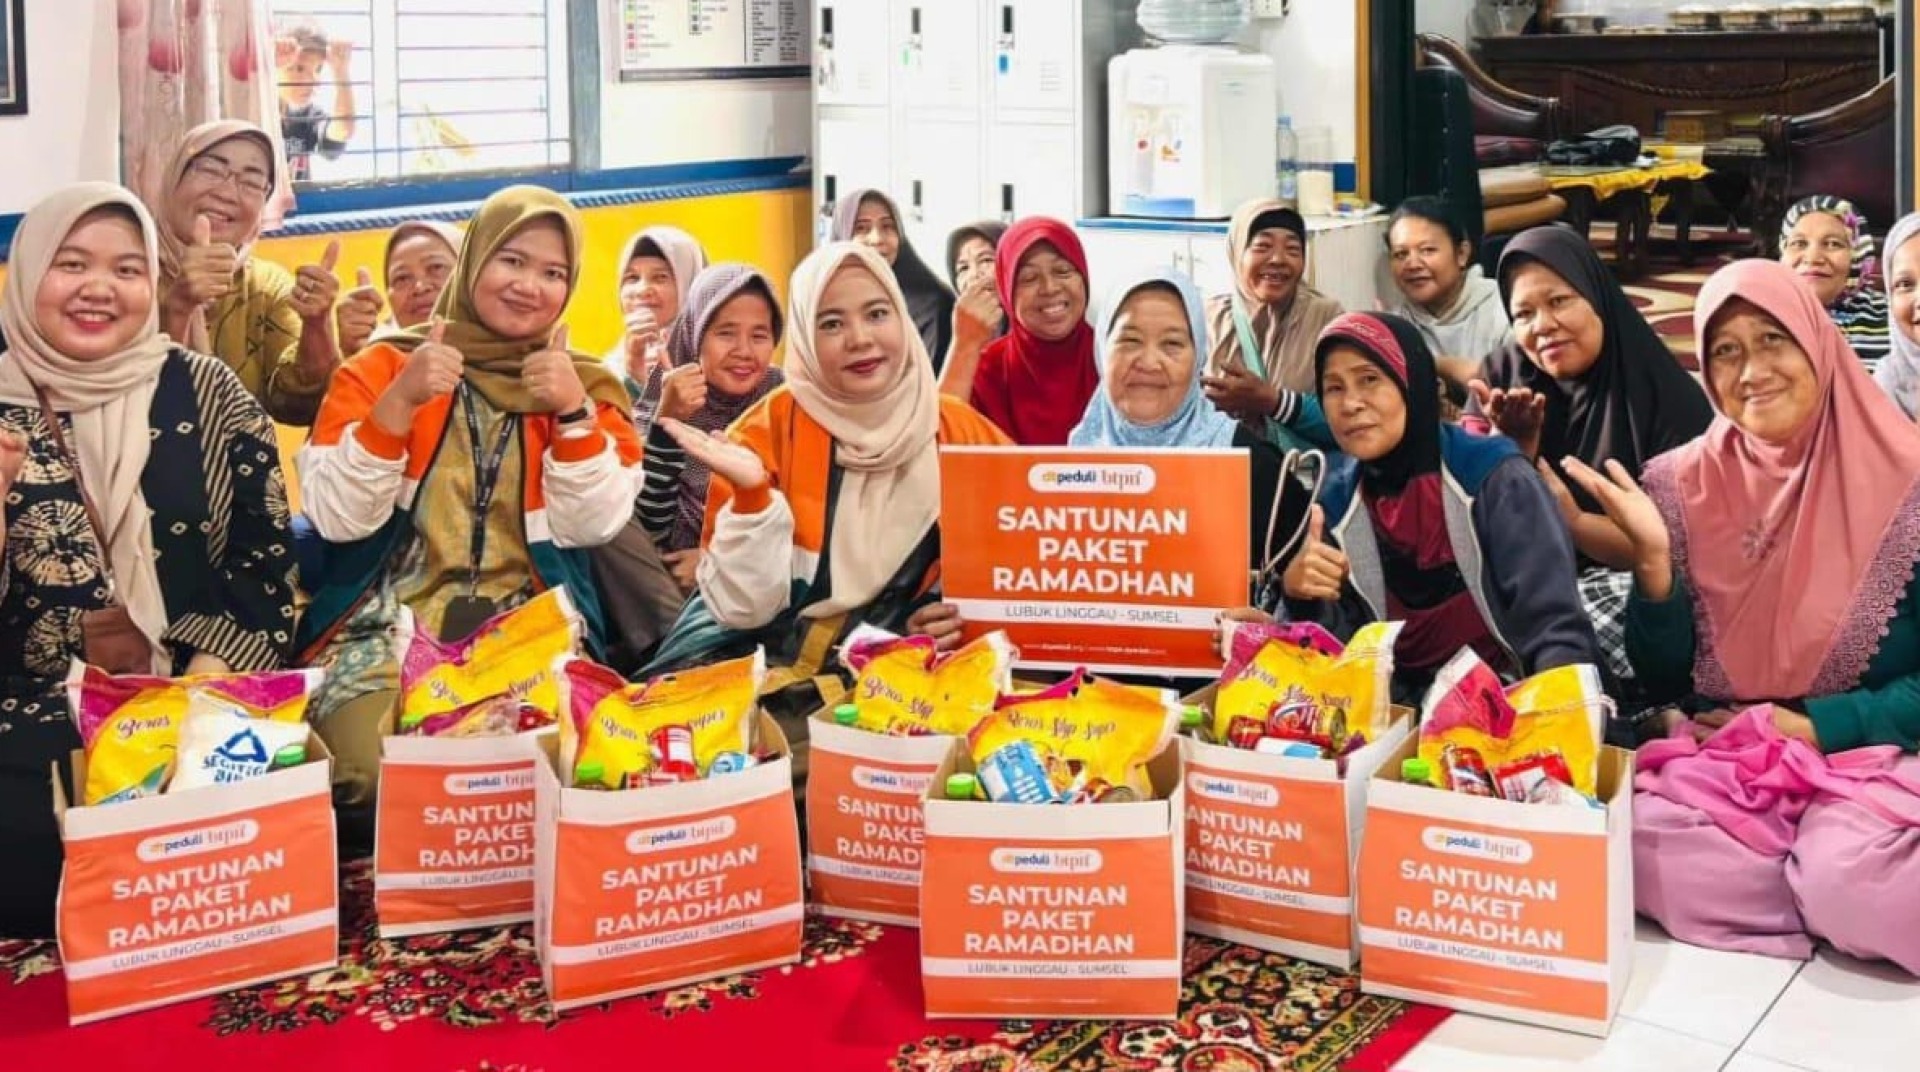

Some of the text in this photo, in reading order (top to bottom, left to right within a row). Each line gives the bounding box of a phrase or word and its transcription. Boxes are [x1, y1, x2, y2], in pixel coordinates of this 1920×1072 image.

[998, 506, 1187, 534] SANTUNAN
[1038, 537, 1148, 564] PAKET
[993, 567, 1195, 597] RAMADHAN
[1006, 606, 1051, 617] LUBUK
[1056, 607, 1116, 620] LINGGAU
[1127, 610, 1182, 623] SUMSEL
[203, 755, 264, 777] SEGITIG
[422, 801, 534, 825] SANTUN
[837, 795, 923, 823] SANTUN
[1186, 804, 1303, 841] ANTUNAN
[863, 821, 924, 844] PAKE
[1199, 829, 1275, 859] PAKET
[419, 844, 535, 868] RAMADH
[836, 837, 919, 864] RAMAD
[112, 848, 285, 899] SANTUNAN
[601, 844, 759, 890] SANTUNAN
[1187, 848, 1311, 888] AMADHAN
[1400, 859, 1557, 901] SANTUNAN
[151, 879, 252, 917] PAKET
[636, 874, 728, 908] PAKET
[968, 884, 1127, 906] SANTUNAN
[1432, 888, 1525, 920] PAKET
[108, 894, 292, 948] RAMADHAN
[595, 888, 763, 937] RAMADHAN
[1002, 909, 1095, 931] PAKET
[1395, 906, 1564, 949] RAMADHAN
[964, 932, 1134, 955] RAMADHAN
[968, 964, 1008, 974] LUBUK
[1013, 964, 1067, 974] LINGGAU
[1078, 964, 1127, 974] SUMSEL
